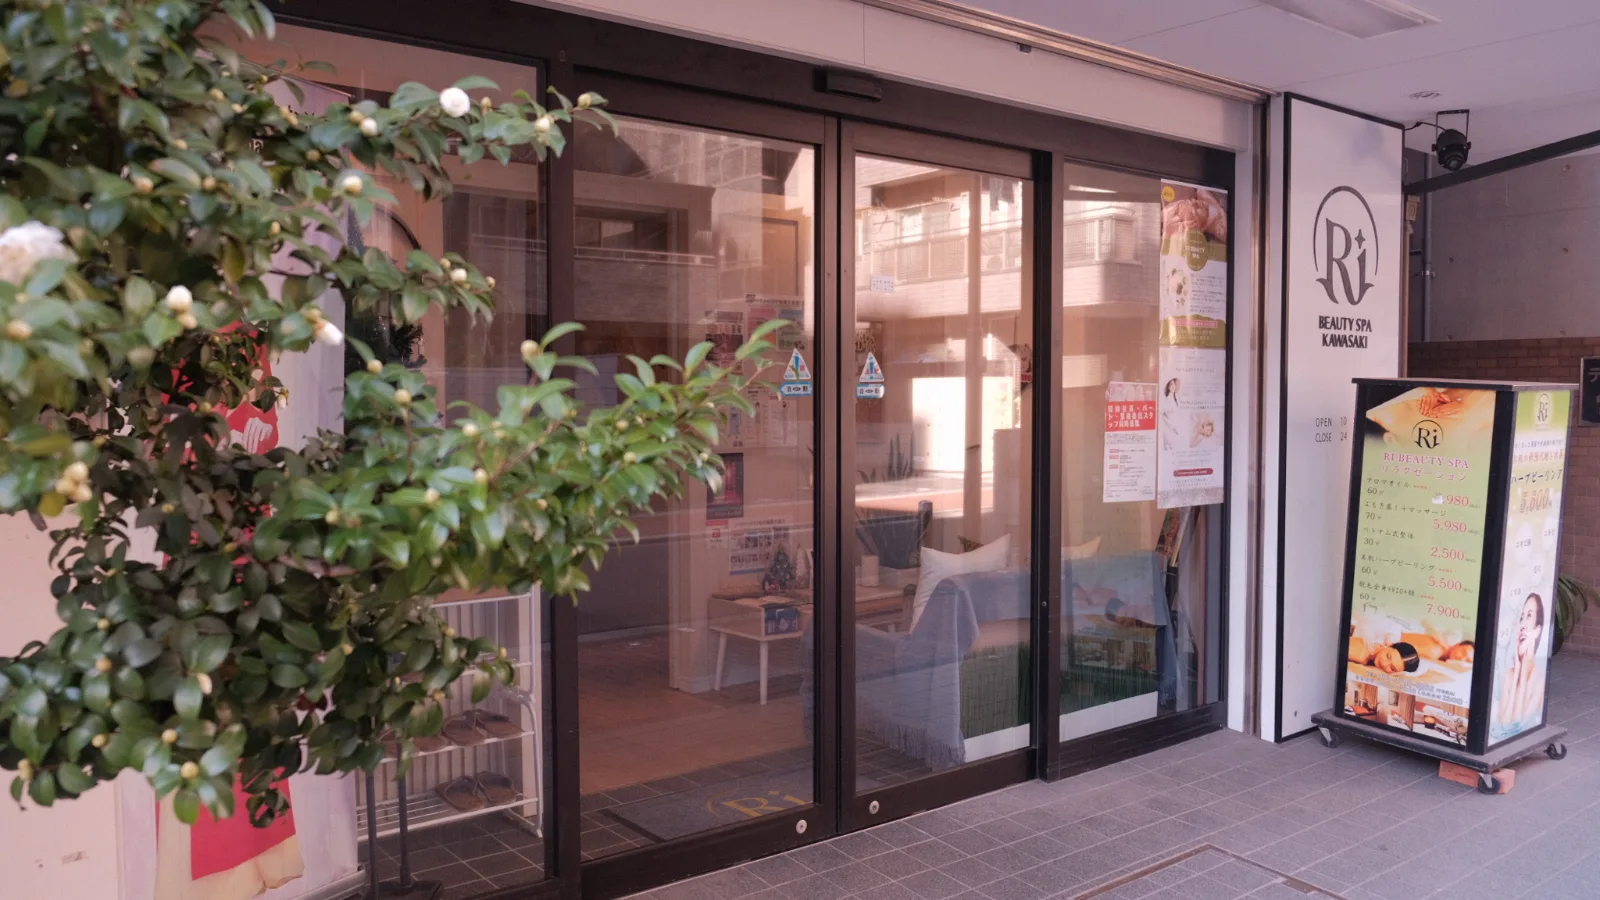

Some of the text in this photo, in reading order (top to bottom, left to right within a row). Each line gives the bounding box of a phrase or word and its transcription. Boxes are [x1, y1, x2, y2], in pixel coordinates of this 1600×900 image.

[1315, 217, 1375, 306] Ri
[1318, 315, 1372, 333] BEAUTY SPA
[1321, 333, 1368, 349] KAWASAKI
[1315, 417, 1333, 428] OPEN
[1315, 431, 1348, 443] CLOSE 24
[1414, 427, 1440, 450] Ri
[1383, 452, 1470, 469] RI BEAUTY SPA
[1381, 464, 1468, 482] リラクゼーション
